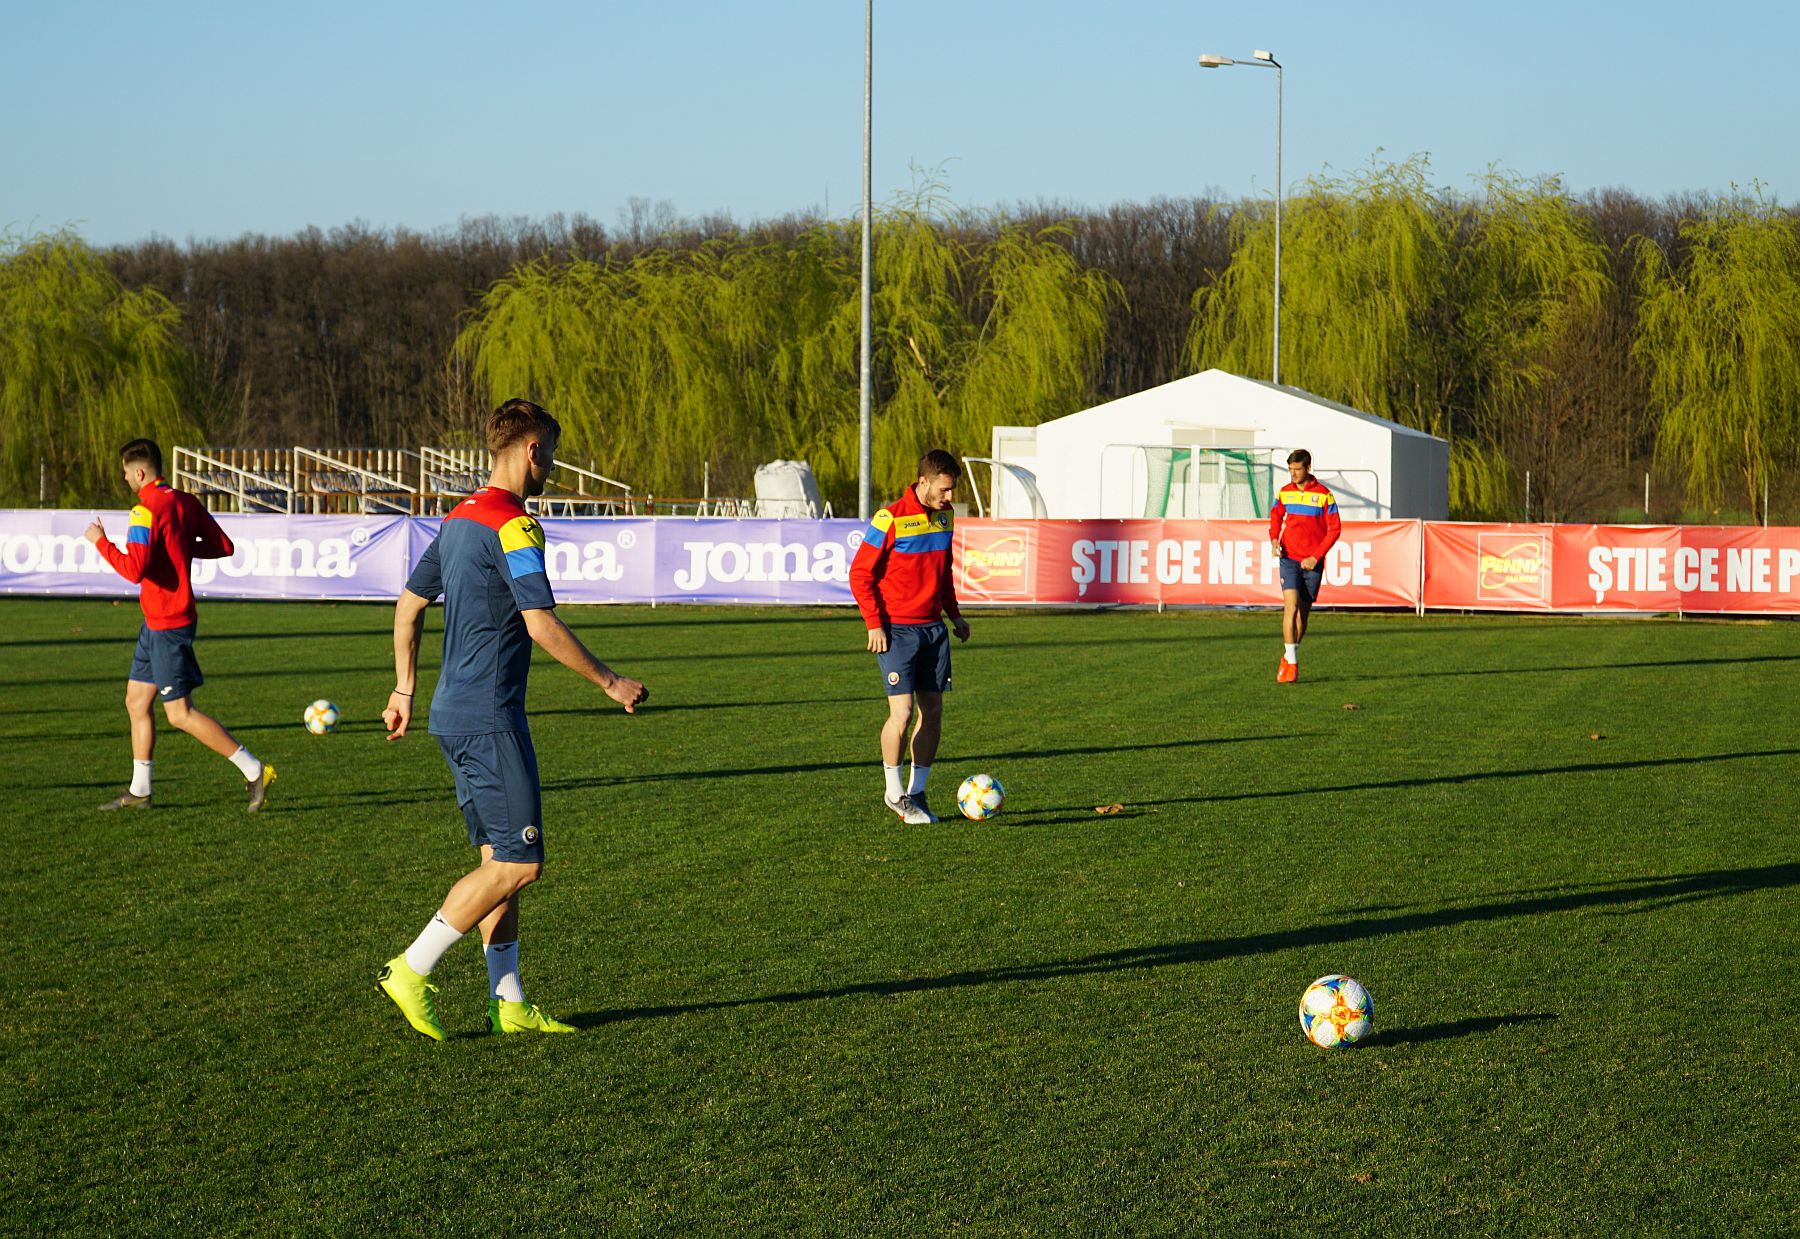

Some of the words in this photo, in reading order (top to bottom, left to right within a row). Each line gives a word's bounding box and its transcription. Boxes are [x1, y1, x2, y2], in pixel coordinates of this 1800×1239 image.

[0, 534, 129, 574] om
[544, 540, 624, 581] ma
[1155, 539, 1201, 585] CE
[1208, 540, 1254, 585] NE
[1260, 540, 1372, 586] PCE
[1480, 555, 1541, 573] PENNY
[1673, 547, 1719, 592] CE
[1726, 548, 1771, 592] NE
